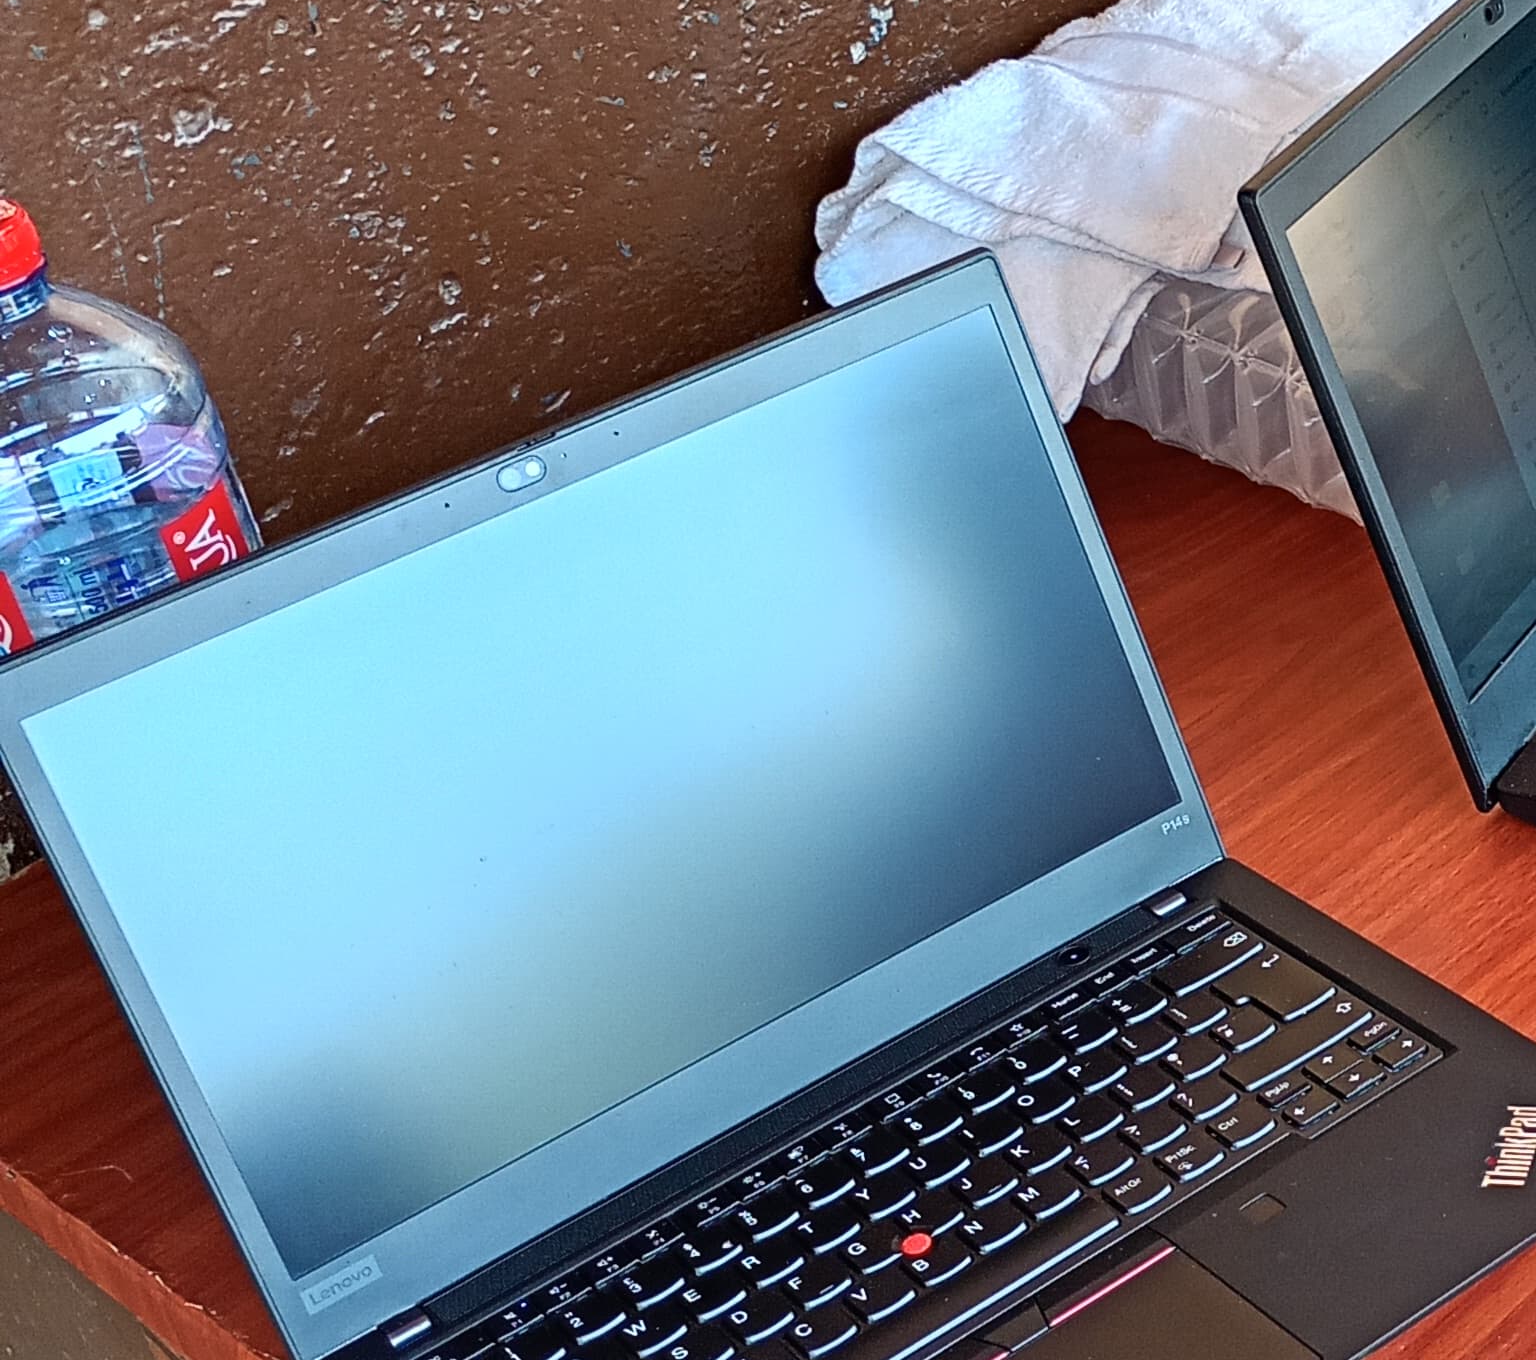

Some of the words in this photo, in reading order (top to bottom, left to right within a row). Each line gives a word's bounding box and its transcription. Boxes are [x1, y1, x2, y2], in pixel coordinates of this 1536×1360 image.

[1067, 1065, 1083, 1078] P
[1016, 1094, 1035, 1107] O
[1063, 1117, 1081, 1127] L
[1009, 1144, 1031, 1158] K
[908, 1156, 928, 1171] U
[961, 1177, 973, 1190] J
[1113, 1176, 1143, 1197] AltGr
[855, 1188, 871, 1201] Y
[1017, 1186, 1041, 1203] M
[901, 1209, 922, 1224] H
[797, 1221, 814, 1234] T
[963, 1220, 984, 1235] N
[847, 1242, 867, 1256] G
[741, 1255, 762, 1270] R
[911, 1259, 930, 1272] B
[309, 1266, 373, 1306] Lenovo
[787, 1276, 803, 1290] F
[682, 1288, 702, 1303] E
[850, 1287, 868, 1302] V
[730, 1310, 748, 1324] D
[623, 1320, 647, 1338] W
[794, 1323, 813, 1337] C
[671, 1346, 689, 1360] S
